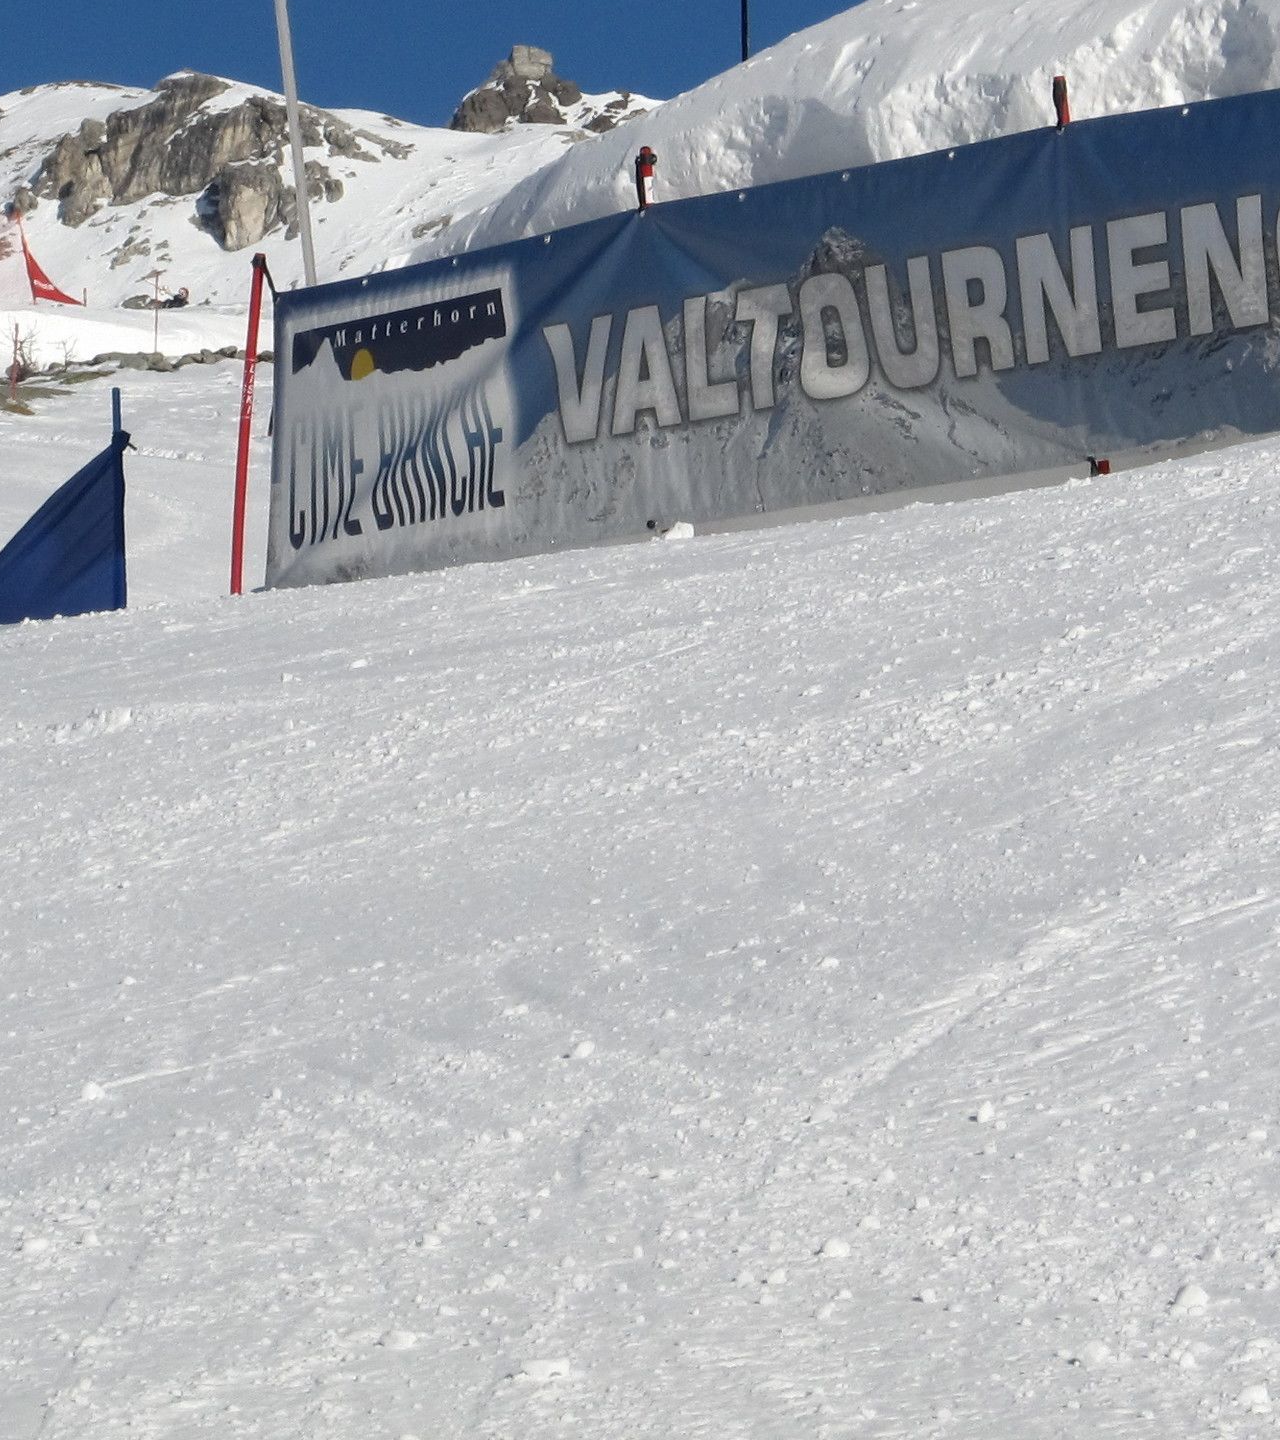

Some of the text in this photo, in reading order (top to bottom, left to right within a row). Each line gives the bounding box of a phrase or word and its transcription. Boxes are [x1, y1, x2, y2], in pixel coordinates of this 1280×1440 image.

[333, 300, 498, 349] Matterhorn
[289, 385, 506, 550] CIME BIANCHE
